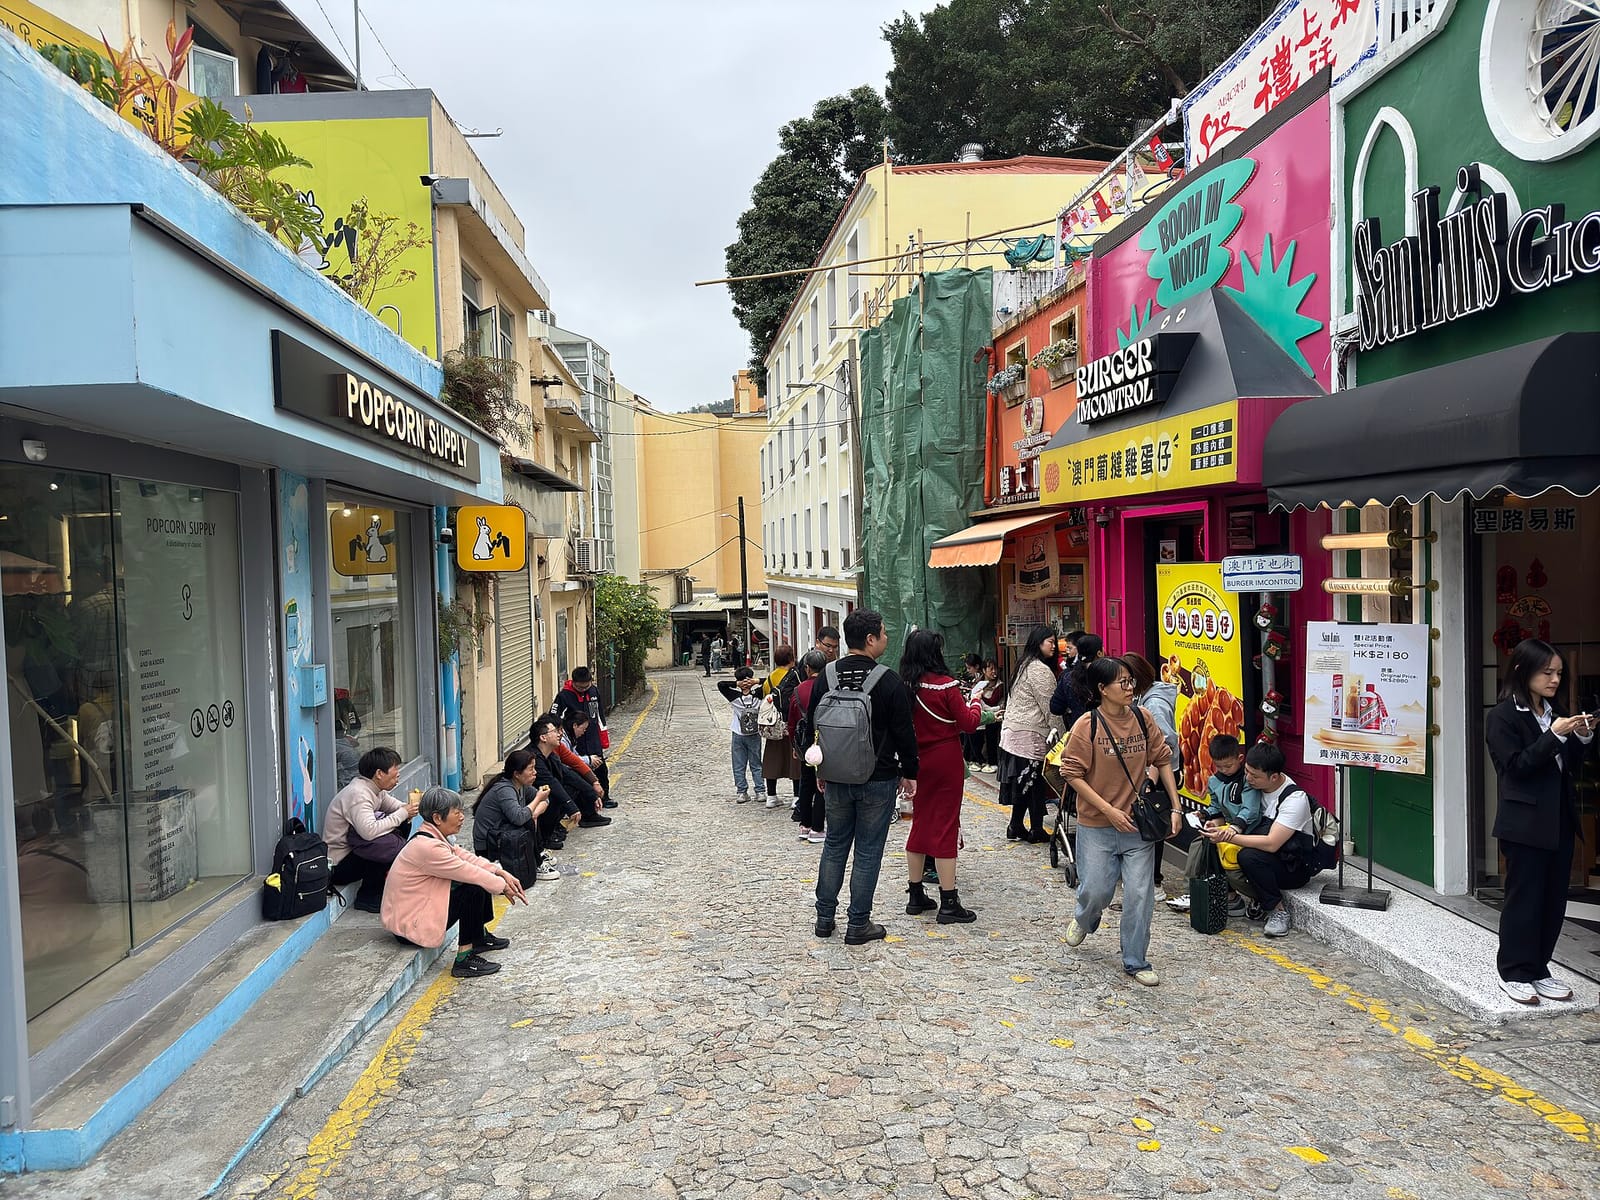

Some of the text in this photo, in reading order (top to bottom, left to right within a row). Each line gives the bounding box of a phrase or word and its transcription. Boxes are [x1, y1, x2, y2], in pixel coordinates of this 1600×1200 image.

[1157, 178, 1226, 255] BOOM IN
[1168, 232, 1212, 292] MOUTH
[1354, 217, 1417, 352] San
[1412, 166, 1501, 330] Luis
[1076, 338, 1153, 399] BURGER
[1076, 377, 1154, 425] IMCONTROL
[346, 373, 468, 468] POPCORN SUPPLY
[1071, 439, 1172, 487] 澳門葡撻雞蛋仔
[146, 518, 216, 537] POPCORN SUPPLY
[1474, 507, 1576, 534] 聖路易斯
[1226, 578, 1298, 588] BURGER IMCONTROL
[1228, 558, 1295, 572] 澳門官也街
[1165, 611, 1230, 635] 葡挞鸡蛋仔
[1174, 640, 1224, 653] PORTUGUESE TART EGGS
[1353, 650, 1409, 660] HK$2180
